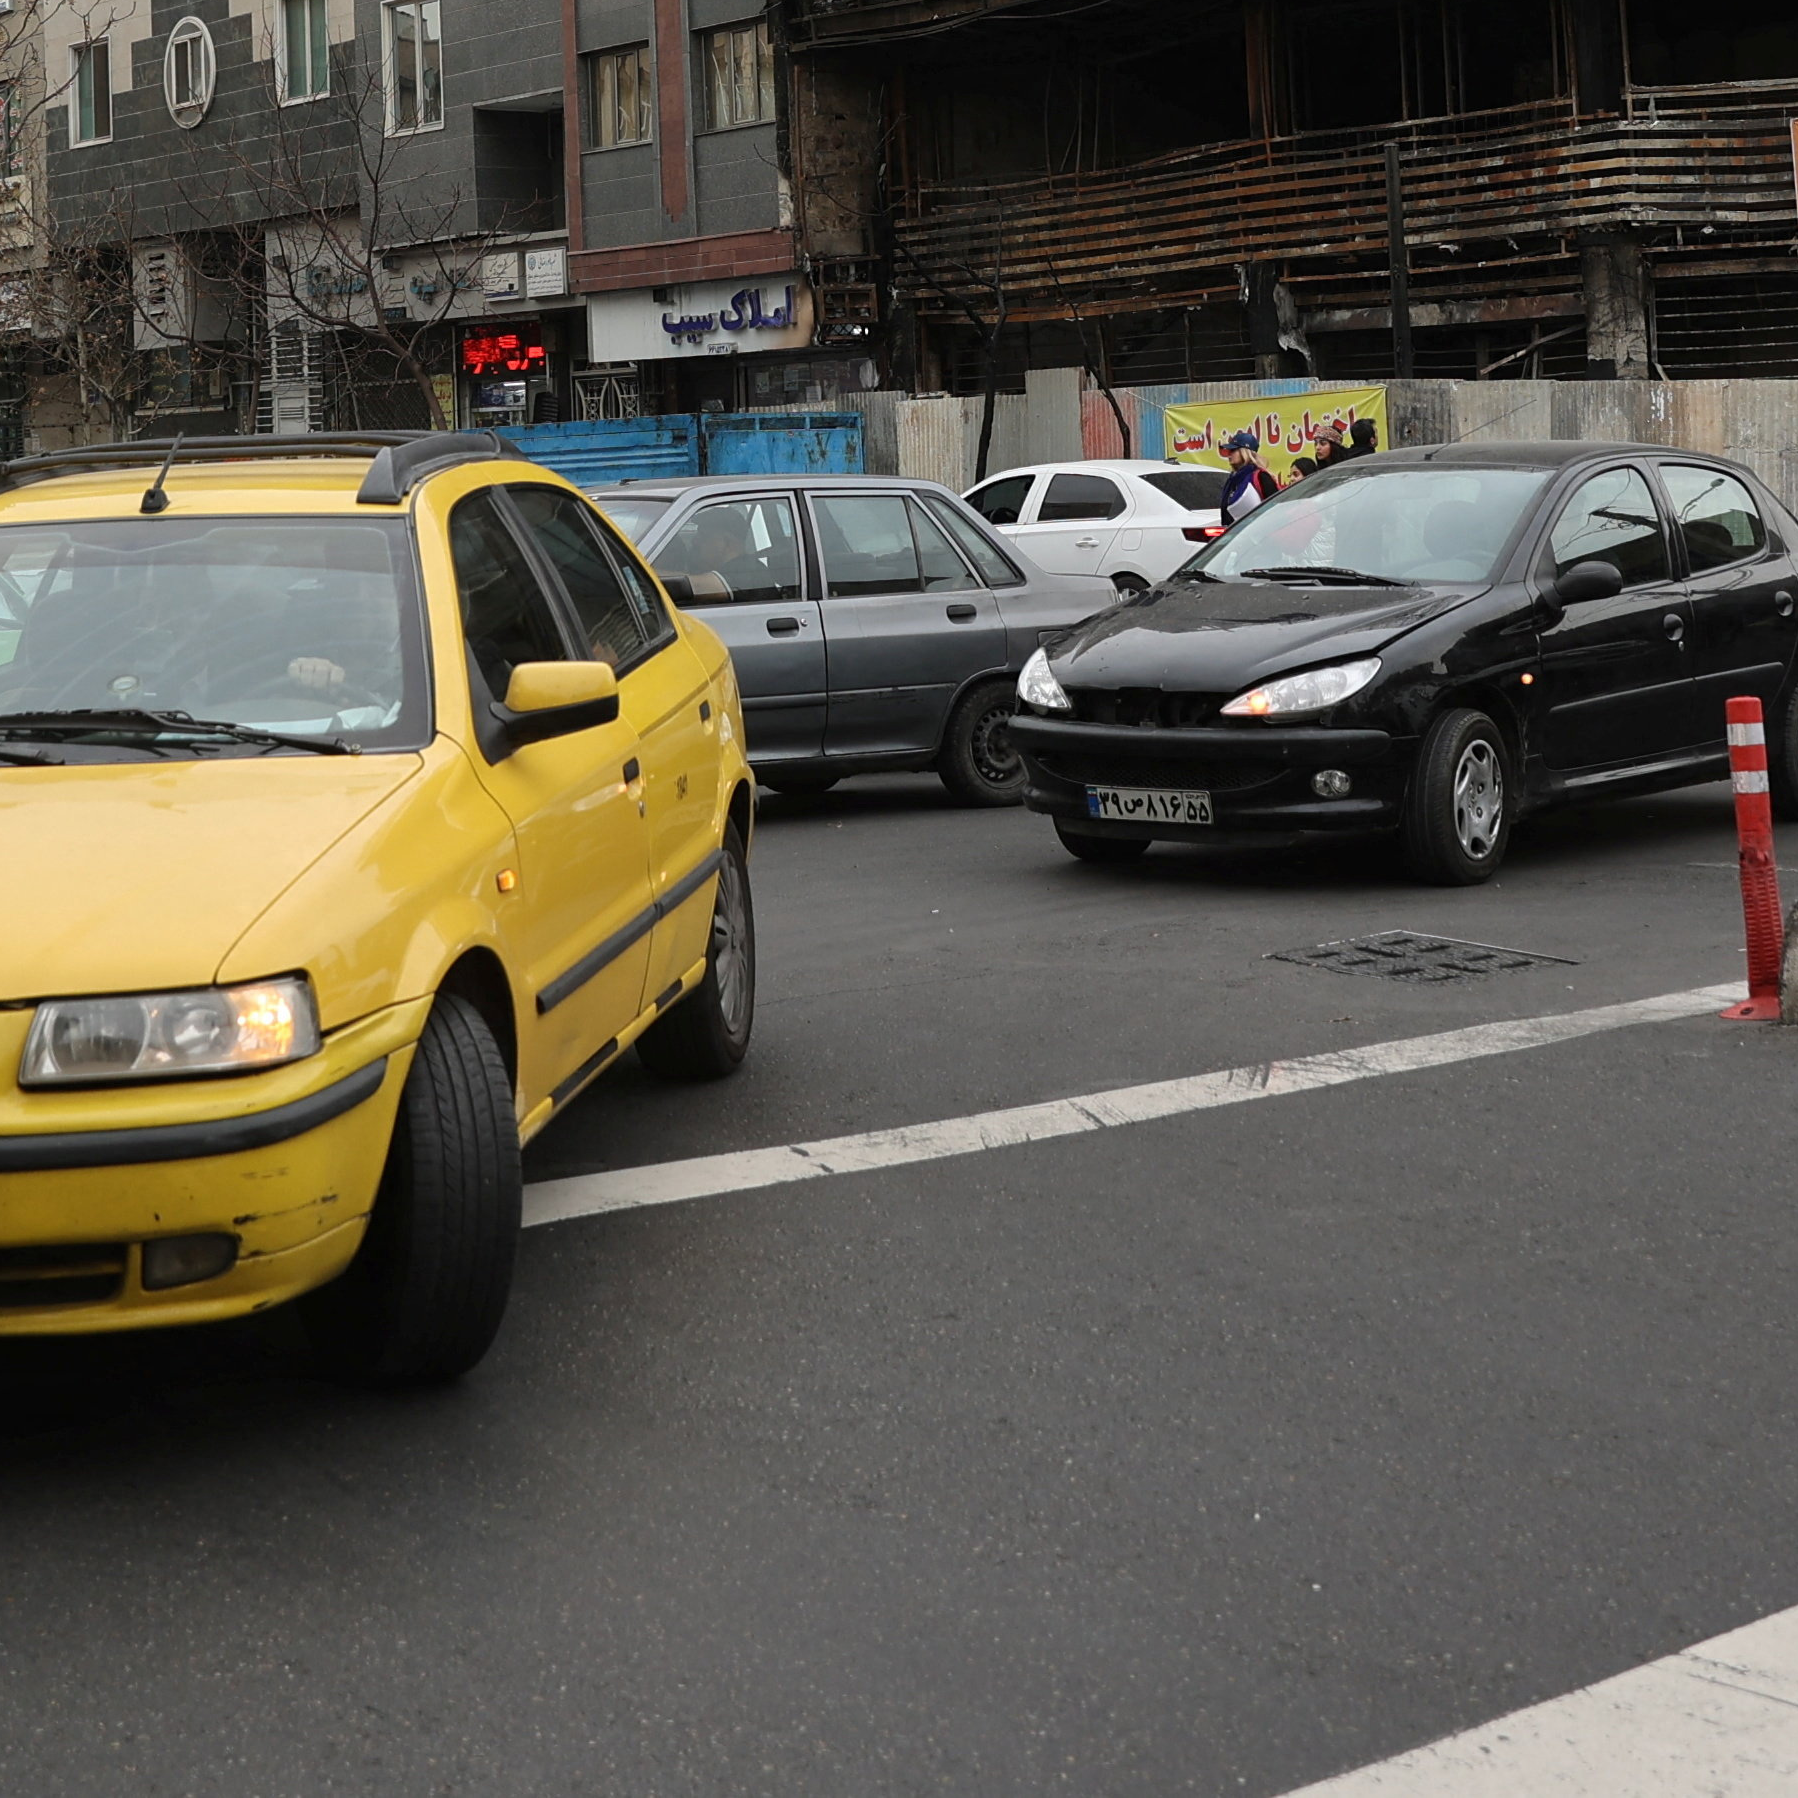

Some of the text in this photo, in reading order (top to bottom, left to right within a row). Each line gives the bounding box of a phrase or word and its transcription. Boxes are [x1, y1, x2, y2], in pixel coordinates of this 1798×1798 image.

[661, 285, 797, 345] املاک سیب
[1173, 419, 1213, 453] است
[1286, 405, 1357, 453] اختمان
[1187, 800, 1210, 822] ۵۵
